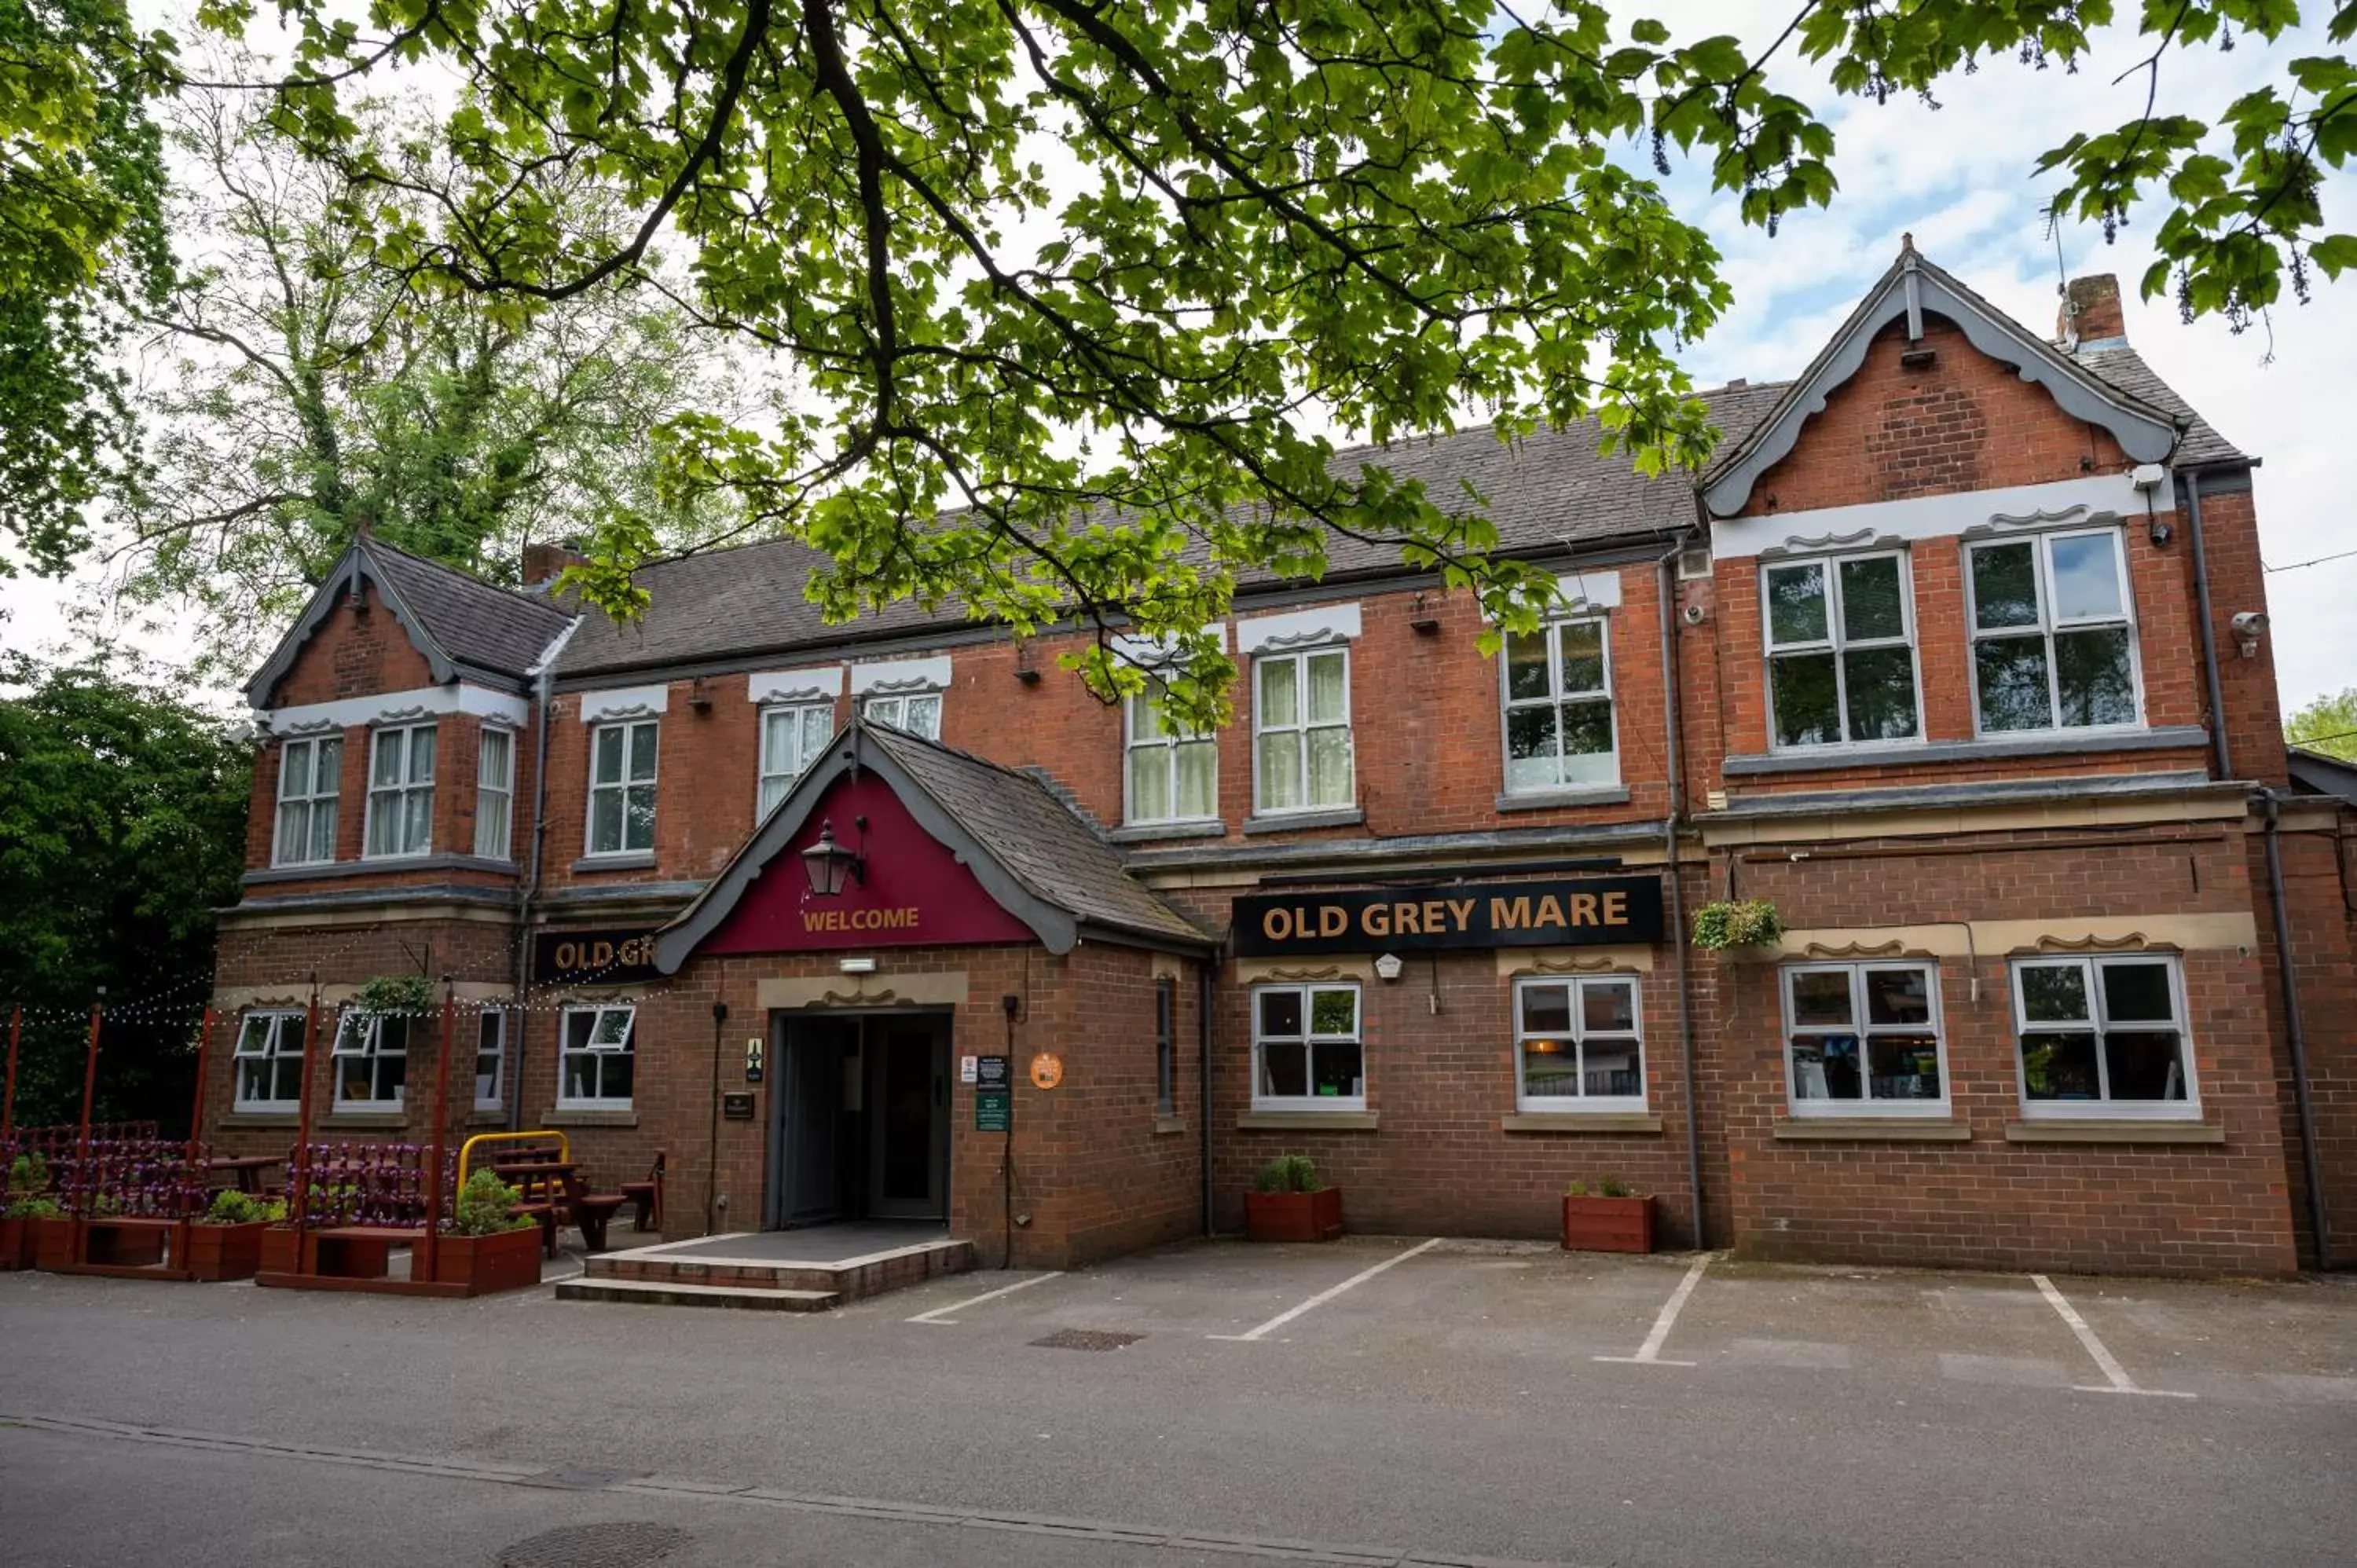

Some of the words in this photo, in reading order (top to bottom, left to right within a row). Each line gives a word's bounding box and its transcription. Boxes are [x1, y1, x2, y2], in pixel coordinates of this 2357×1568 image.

[803, 907, 919, 932] WELCOME
[1263, 906, 1349, 940] OLD
[1361, 898, 1476, 936] GREY
[1490, 891, 1629, 930] MARE
[555, 941, 614, 969] OLD
